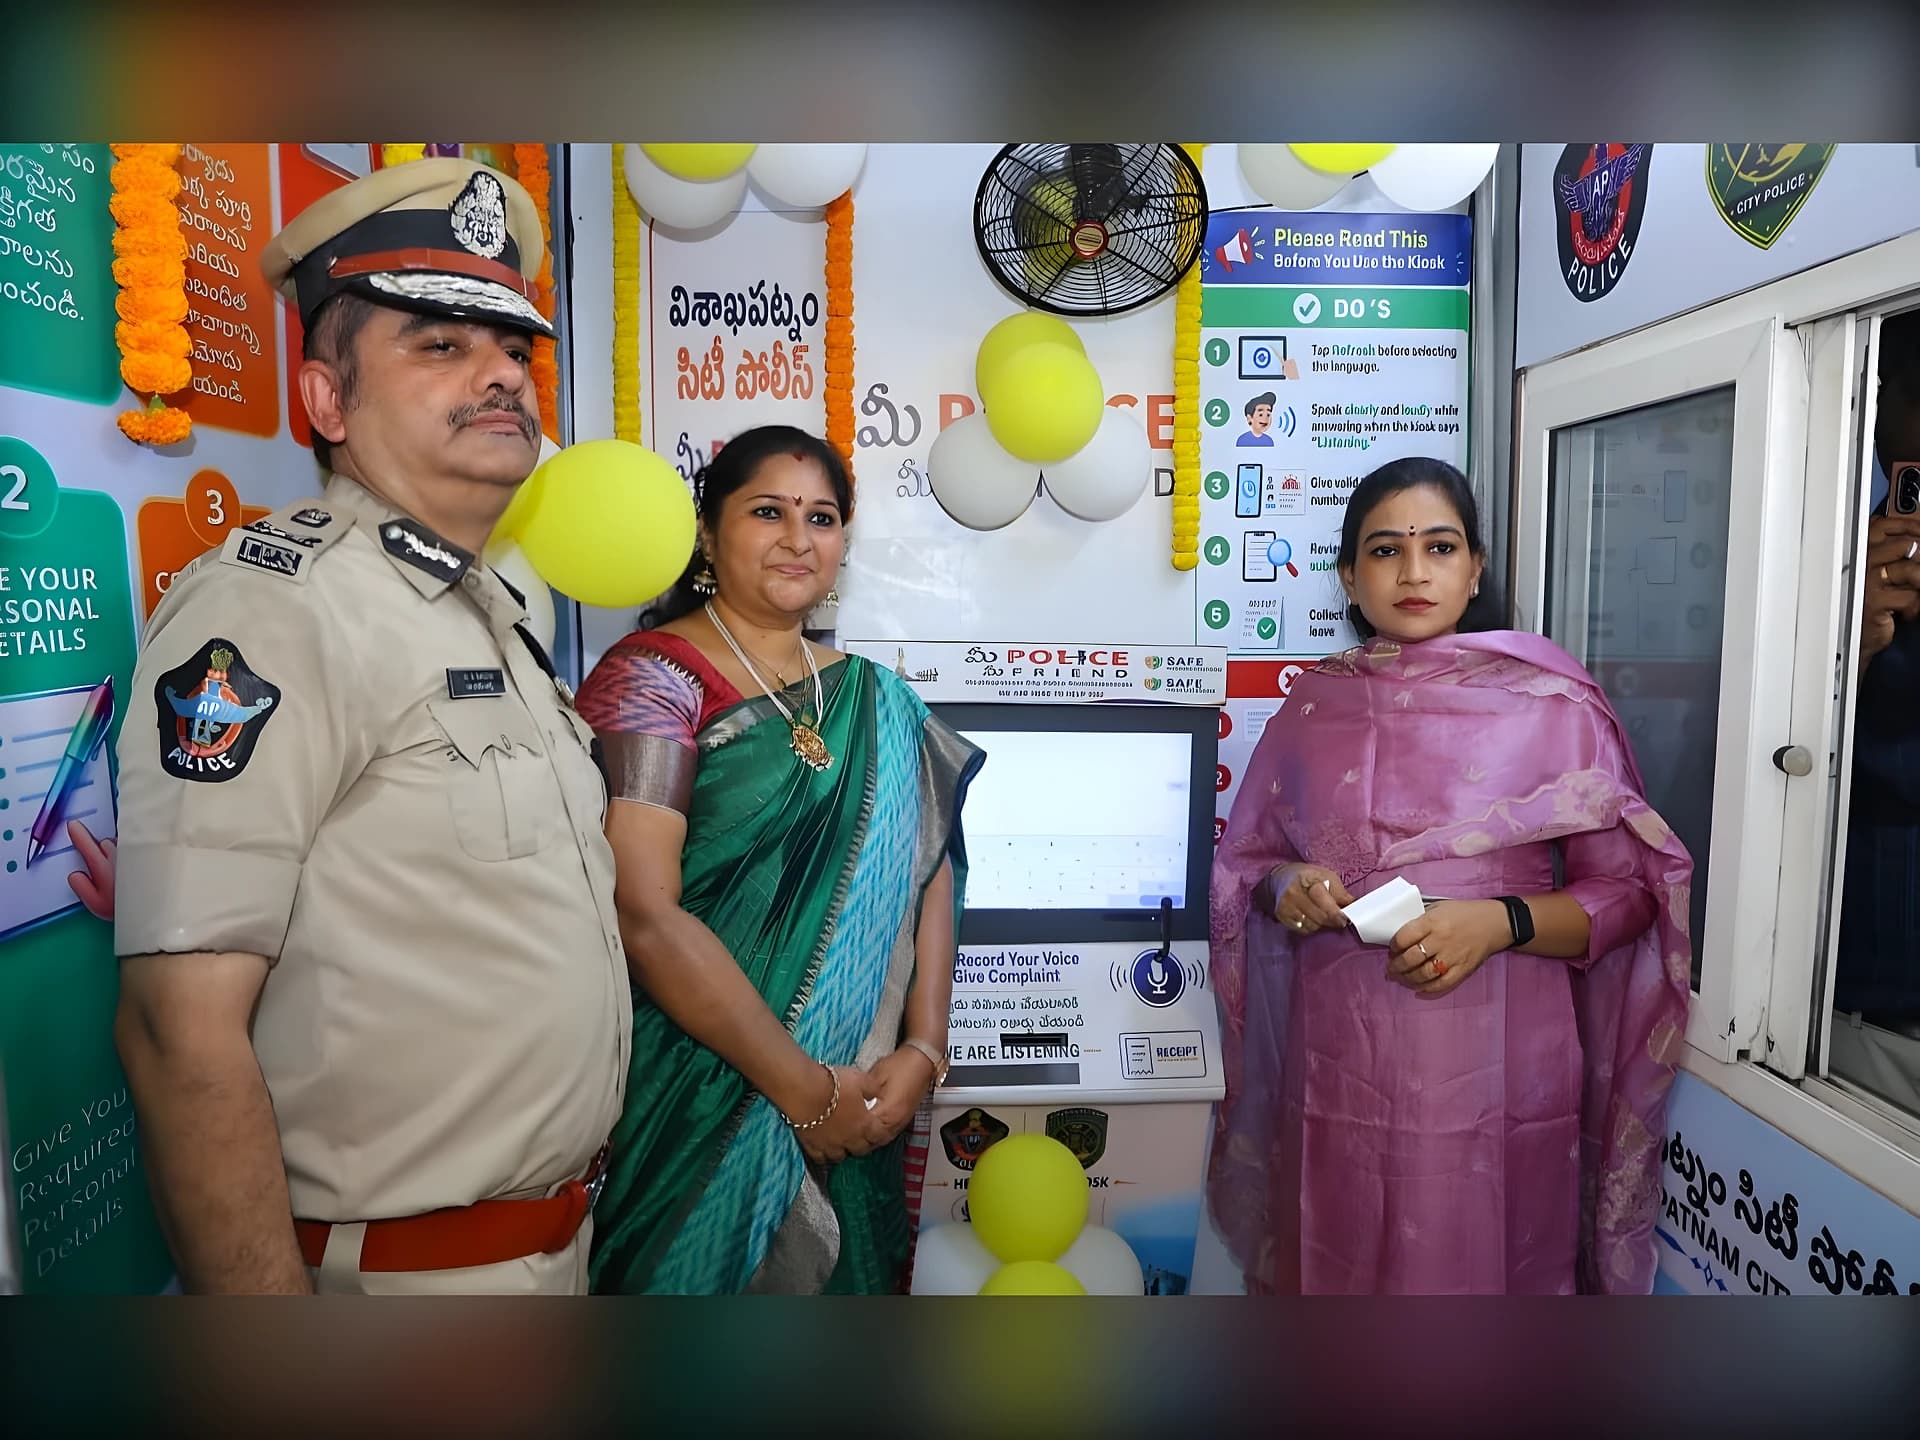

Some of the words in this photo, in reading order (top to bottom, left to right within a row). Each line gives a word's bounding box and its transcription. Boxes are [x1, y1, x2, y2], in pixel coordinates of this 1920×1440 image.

[1736, 193, 1761, 214] CITY
[1764, 172, 1805, 202] POLICE
[1274, 228, 1335, 248] Please
[1339, 229, 1386, 249] Read
[1388, 230, 1429, 249] This
[1274, 253, 1321, 269] Before
[1324, 254, 1351, 269] You
[1353, 254, 1379, 269] Use
[1381, 255, 1405, 269] the
[1408, 255, 1446, 270] Kiosk
[1567, 233, 1631, 295] POLICE
[1213, 345, 1221, 361] 1
[1311, 344, 1330, 358] Tap
[677, 336, 725, 401] సిటీ
[1211, 406, 1222, 420] 2
[1311, 404, 1342, 418] Speak
[1380, 404, 1400, 416] and
[1211, 479, 1222, 493] 3
[207, 489, 225, 525] 3
[1210, 543, 1223, 558] 4
[20, 567, 98, 591] YOUR
[0, 597, 99, 624] SONAL
[1211, 607, 1222, 622] 5
[1166, 655, 1204, 667] SAFE
[956, 951, 1005, 967] Record
[1009, 951, 1040, 967] Your
[1043, 950, 1079, 967] Voice
[988, 967, 1062, 987] Complaint
[967, 1045, 997, 1060] ARE
[1156, 1046, 1198, 1058] RECEIPT
